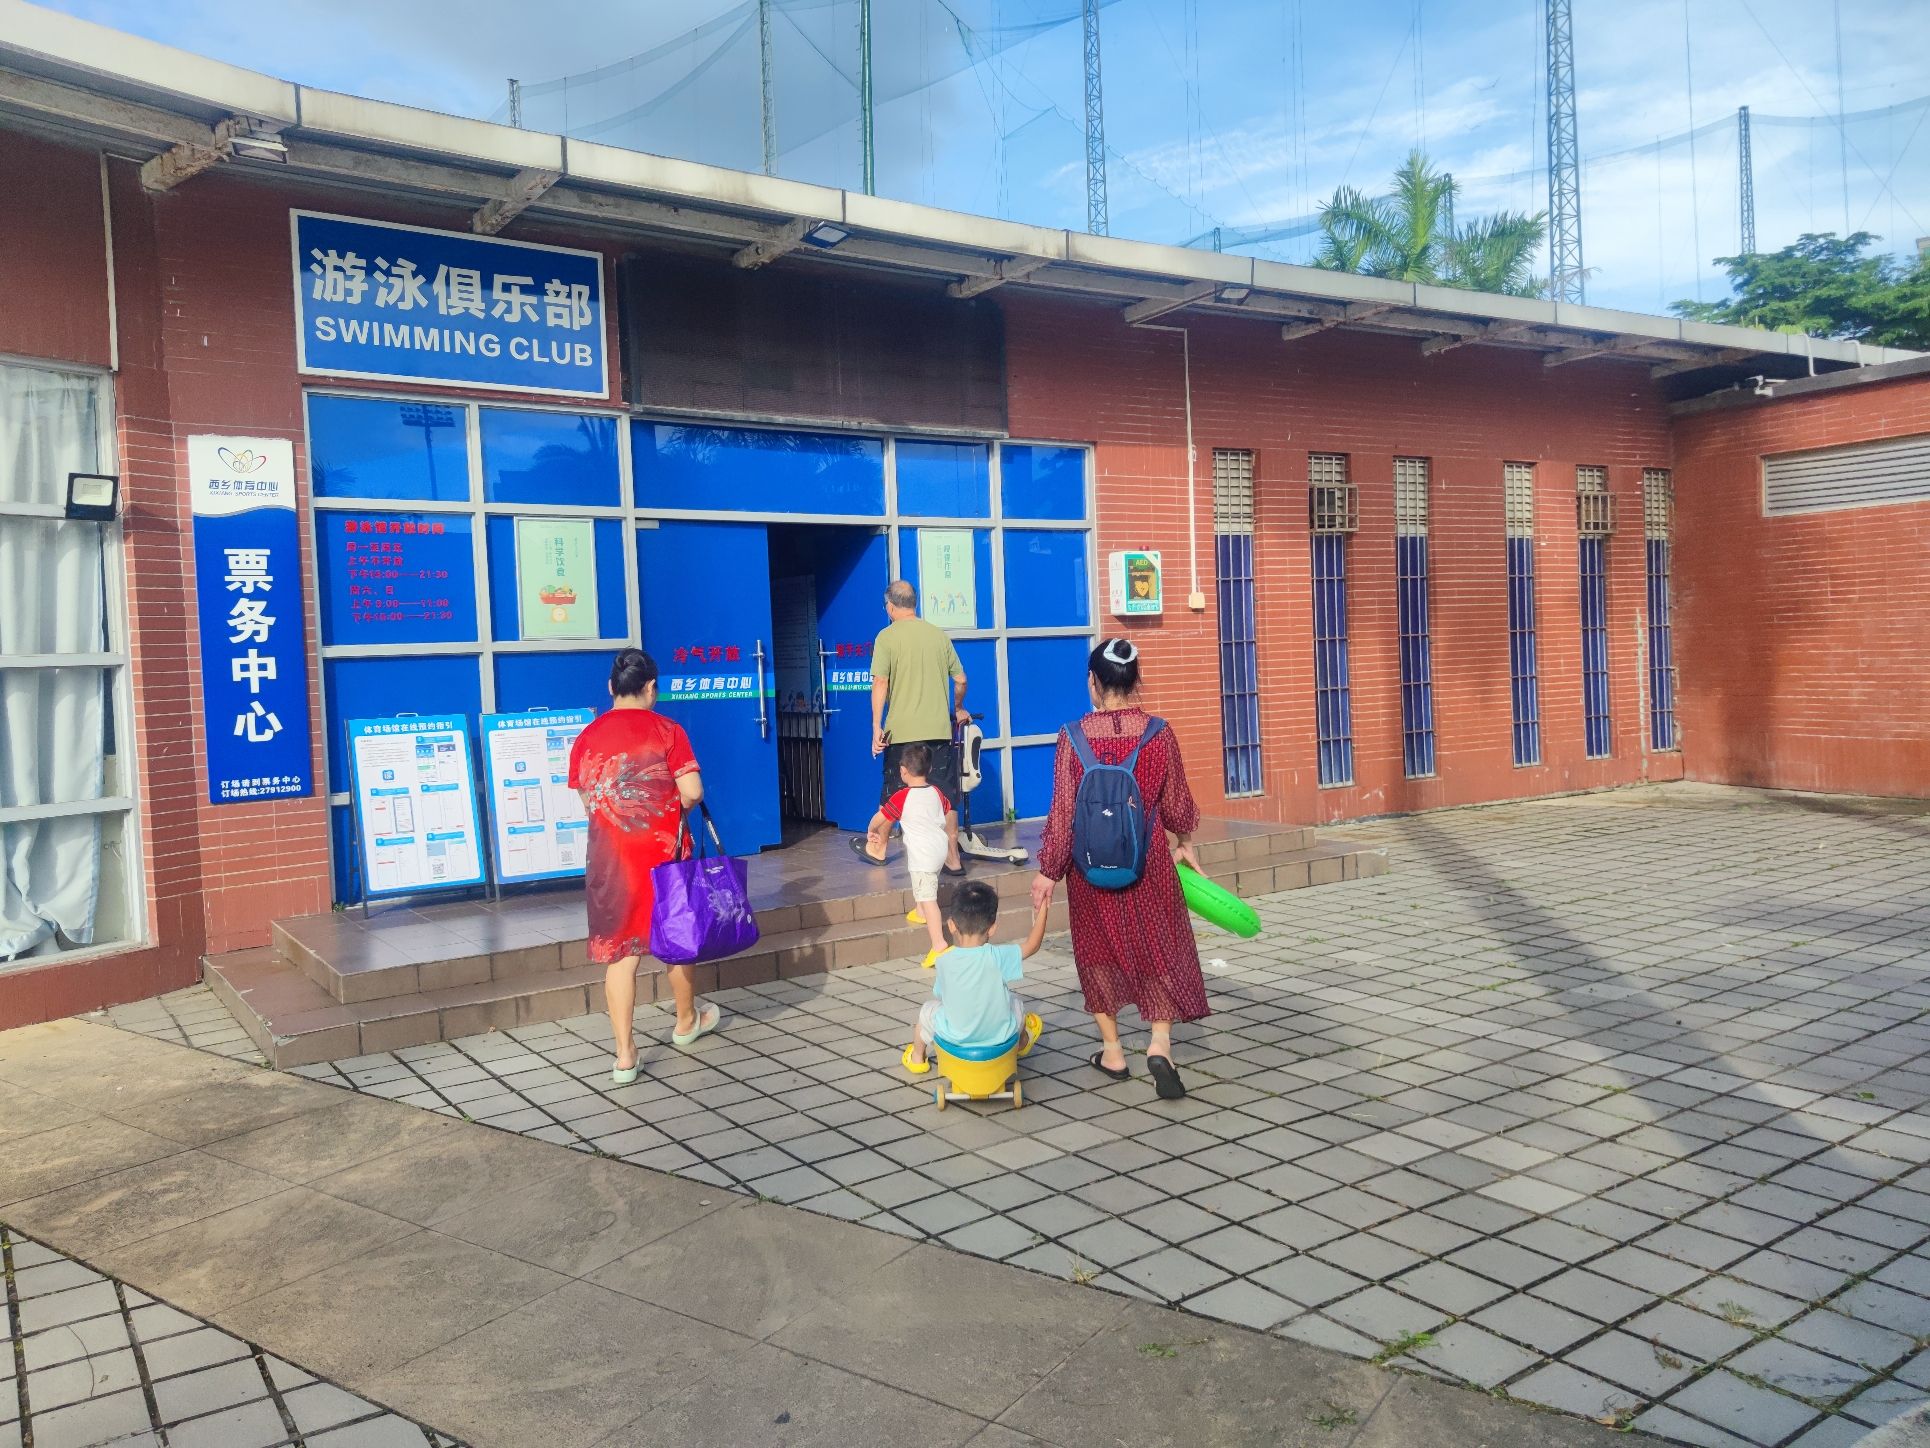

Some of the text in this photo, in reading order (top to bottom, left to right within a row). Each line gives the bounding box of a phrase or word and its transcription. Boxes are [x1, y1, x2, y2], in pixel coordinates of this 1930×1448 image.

[310, 247, 592, 331] 游泳俱乐部
[315, 316, 593, 367] SWIMMING CLUB
[208, 479, 279, 492] 西乡体育中心
[223, 548, 283, 742] 票务中心
[671, 676, 752, 691] 西乡体育中心
[671, 692, 699, 700] XIXIANG
[701, 691, 727, 699] SPORTS
[220, 775, 301, 789] 订场请到票务中心
